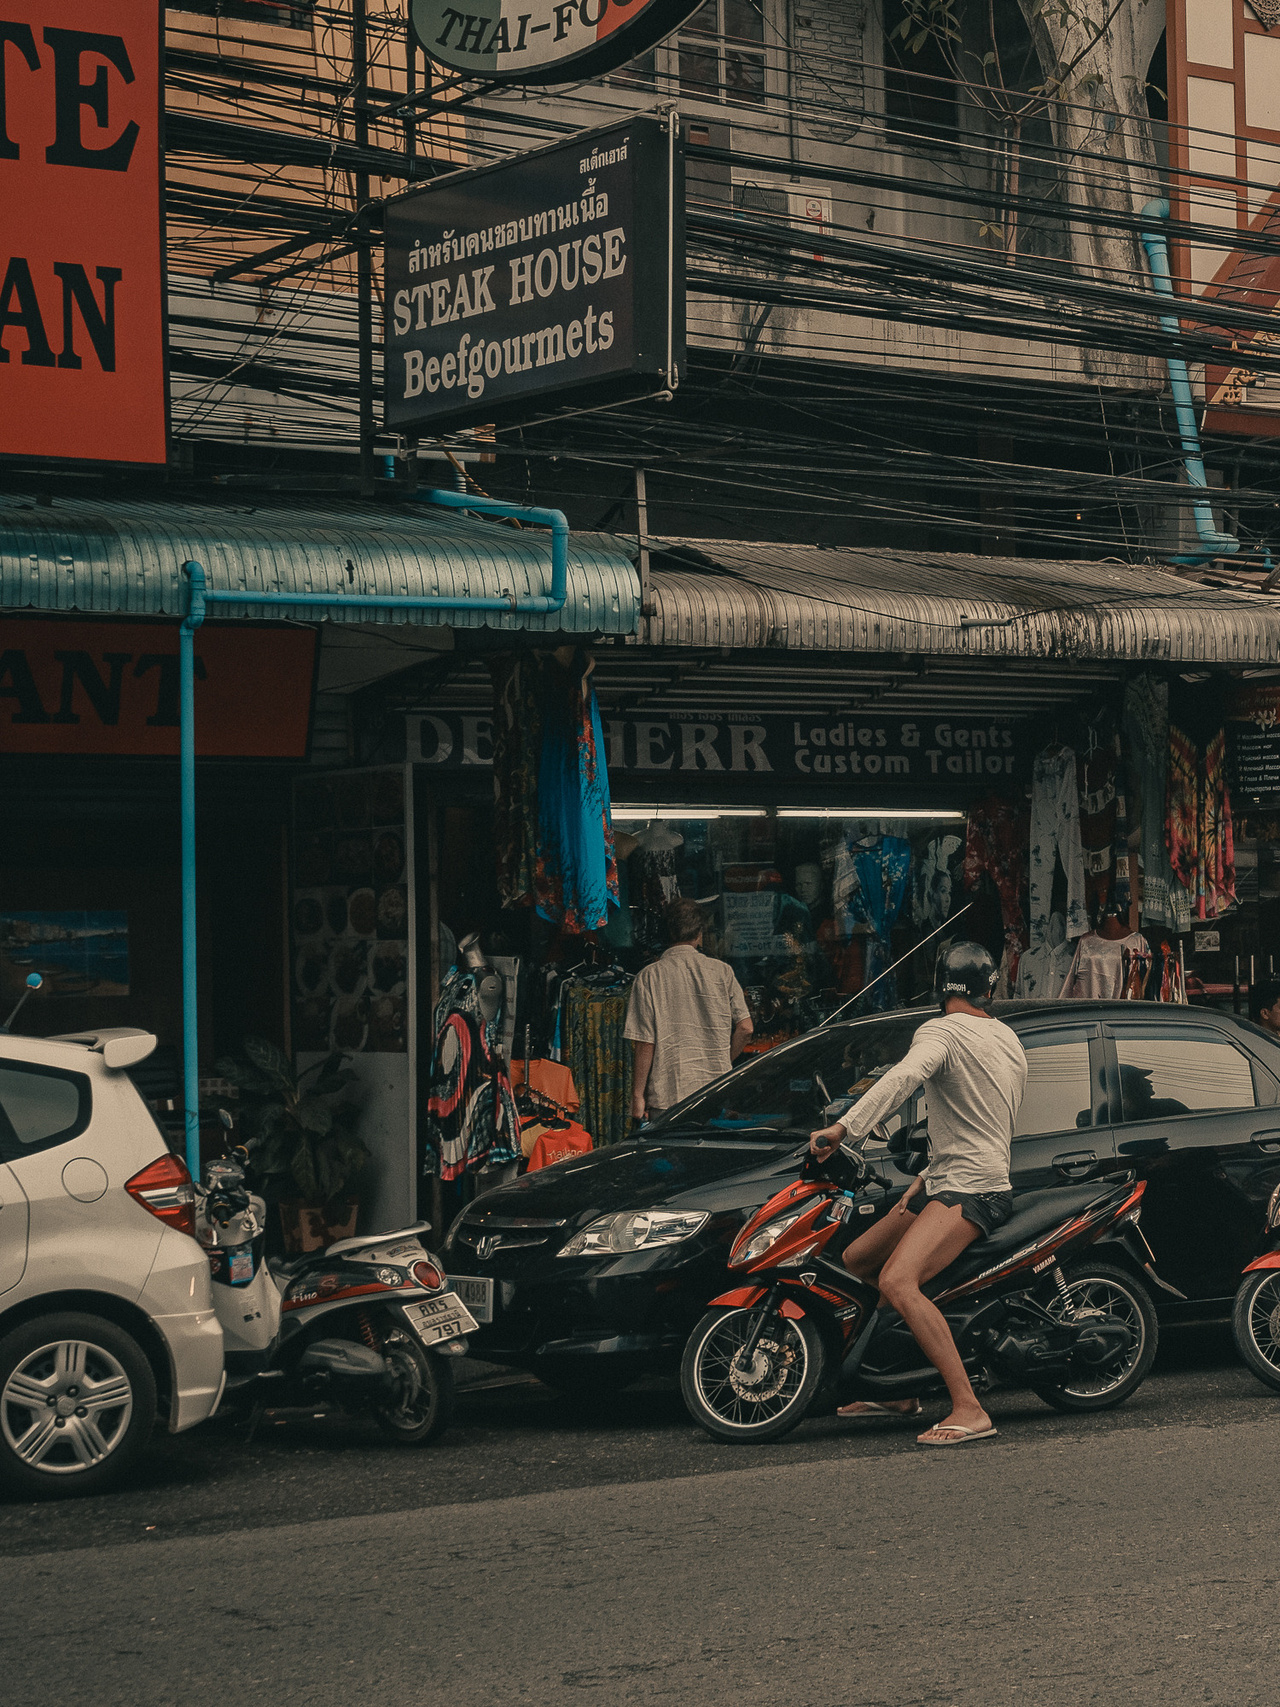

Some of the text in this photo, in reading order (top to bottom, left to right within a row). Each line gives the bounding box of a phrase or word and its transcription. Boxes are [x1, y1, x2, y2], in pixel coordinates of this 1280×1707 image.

[435, 0, 633, 54] THAI-FO
[408, 178, 609, 273] สำหรับคนชอบทานเนื้อ
[394, 227, 627, 336] STEAK HOUSE
[404, 305, 614, 399] Beefgourmets
[405, 714, 494, 765] DE
[794, 722, 1013, 748] Ladies & Gents
[795, 749, 1016, 774] Custom Tailor
[1032, 1254, 1057, 1274] YAMAHA
[432, 1320, 461, 1338] 797
